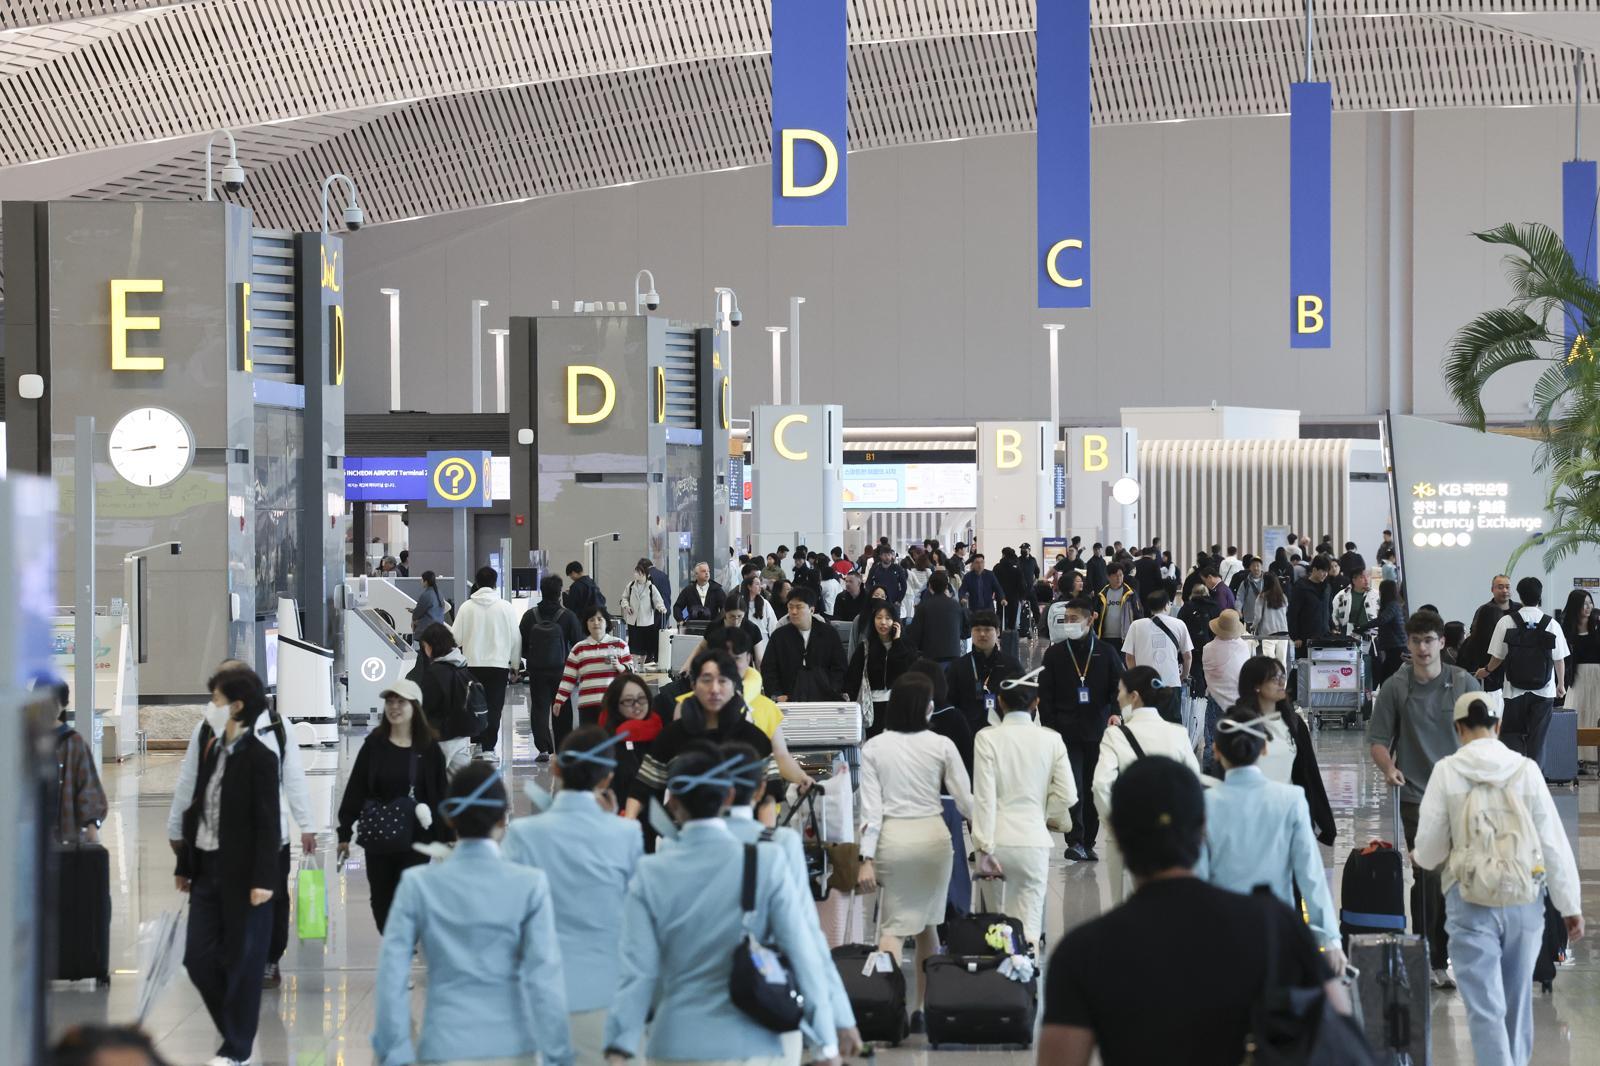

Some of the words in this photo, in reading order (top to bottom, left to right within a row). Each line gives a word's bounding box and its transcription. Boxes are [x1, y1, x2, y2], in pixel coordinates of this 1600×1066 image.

[781, 128, 839, 198] D
[1046, 239, 1083, 288] C
[111, 279, 164, 371] E
[1298, 295, 1324, 334] B
[568, 365, 616, 424] D
[773, 414, 808, 461] C
[996, 429, 1023, 469] B
[1084, 435, 1109, 471] B
[1412, 515, 1474, 532] Currency
[1477, 515, 1542, 532] Exchange
